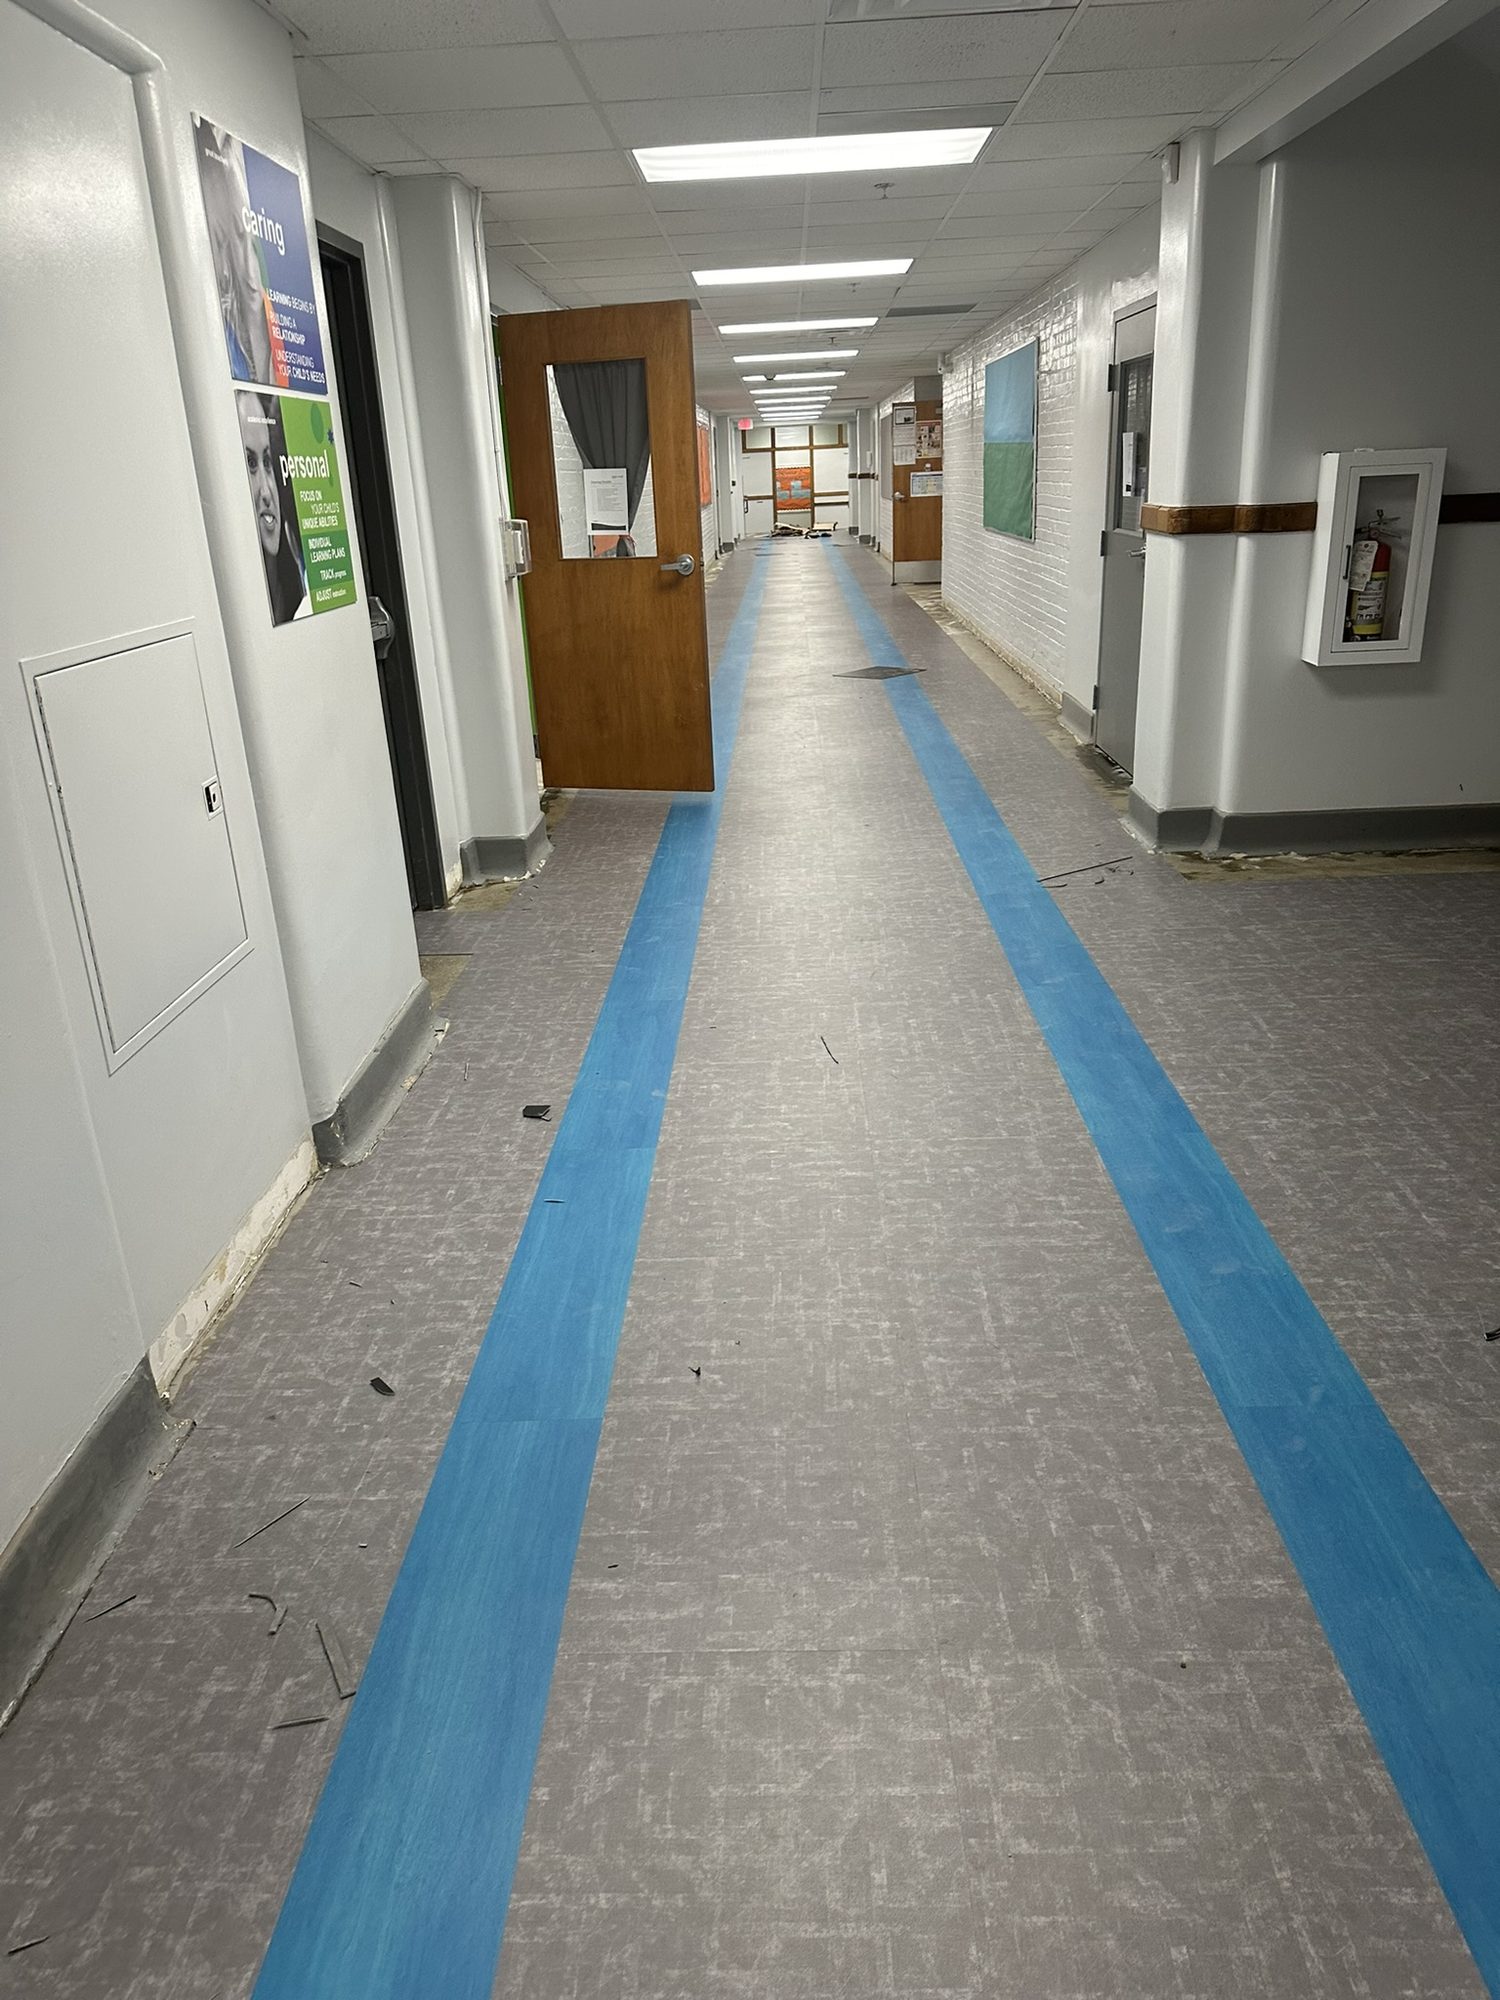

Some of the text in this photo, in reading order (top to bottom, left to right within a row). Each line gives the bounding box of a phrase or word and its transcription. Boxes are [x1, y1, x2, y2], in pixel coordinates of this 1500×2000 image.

[242, 206, 285, 255] caring
[267, 288, 292, 305] LEARNING
[292, 297, 309, 312] BEGINS
[270, 311, 292, 327] BUILDING
[271, 326, 306, 345] RELATIONSHIP
[275, 350, 314, 367] UNDERSTANDING
[277, 363, 325, 384] YOUR CHILD'S NEEDS
[280, 449, 329, 486] personal
[300, 490, 322, 501] FOCUS ON
[310, 502, 340, 515] YOUR CHILD'S
[301, 515, 338, 529] UNIQUE ABILITIES
[308, 537, 331, 549] INDIVIDUAL
[310, 547, 346, 562] LEARNING PLANS
[320, 568, 334, 580] TRACK
[316, 588, 332, 602] ADJUST
